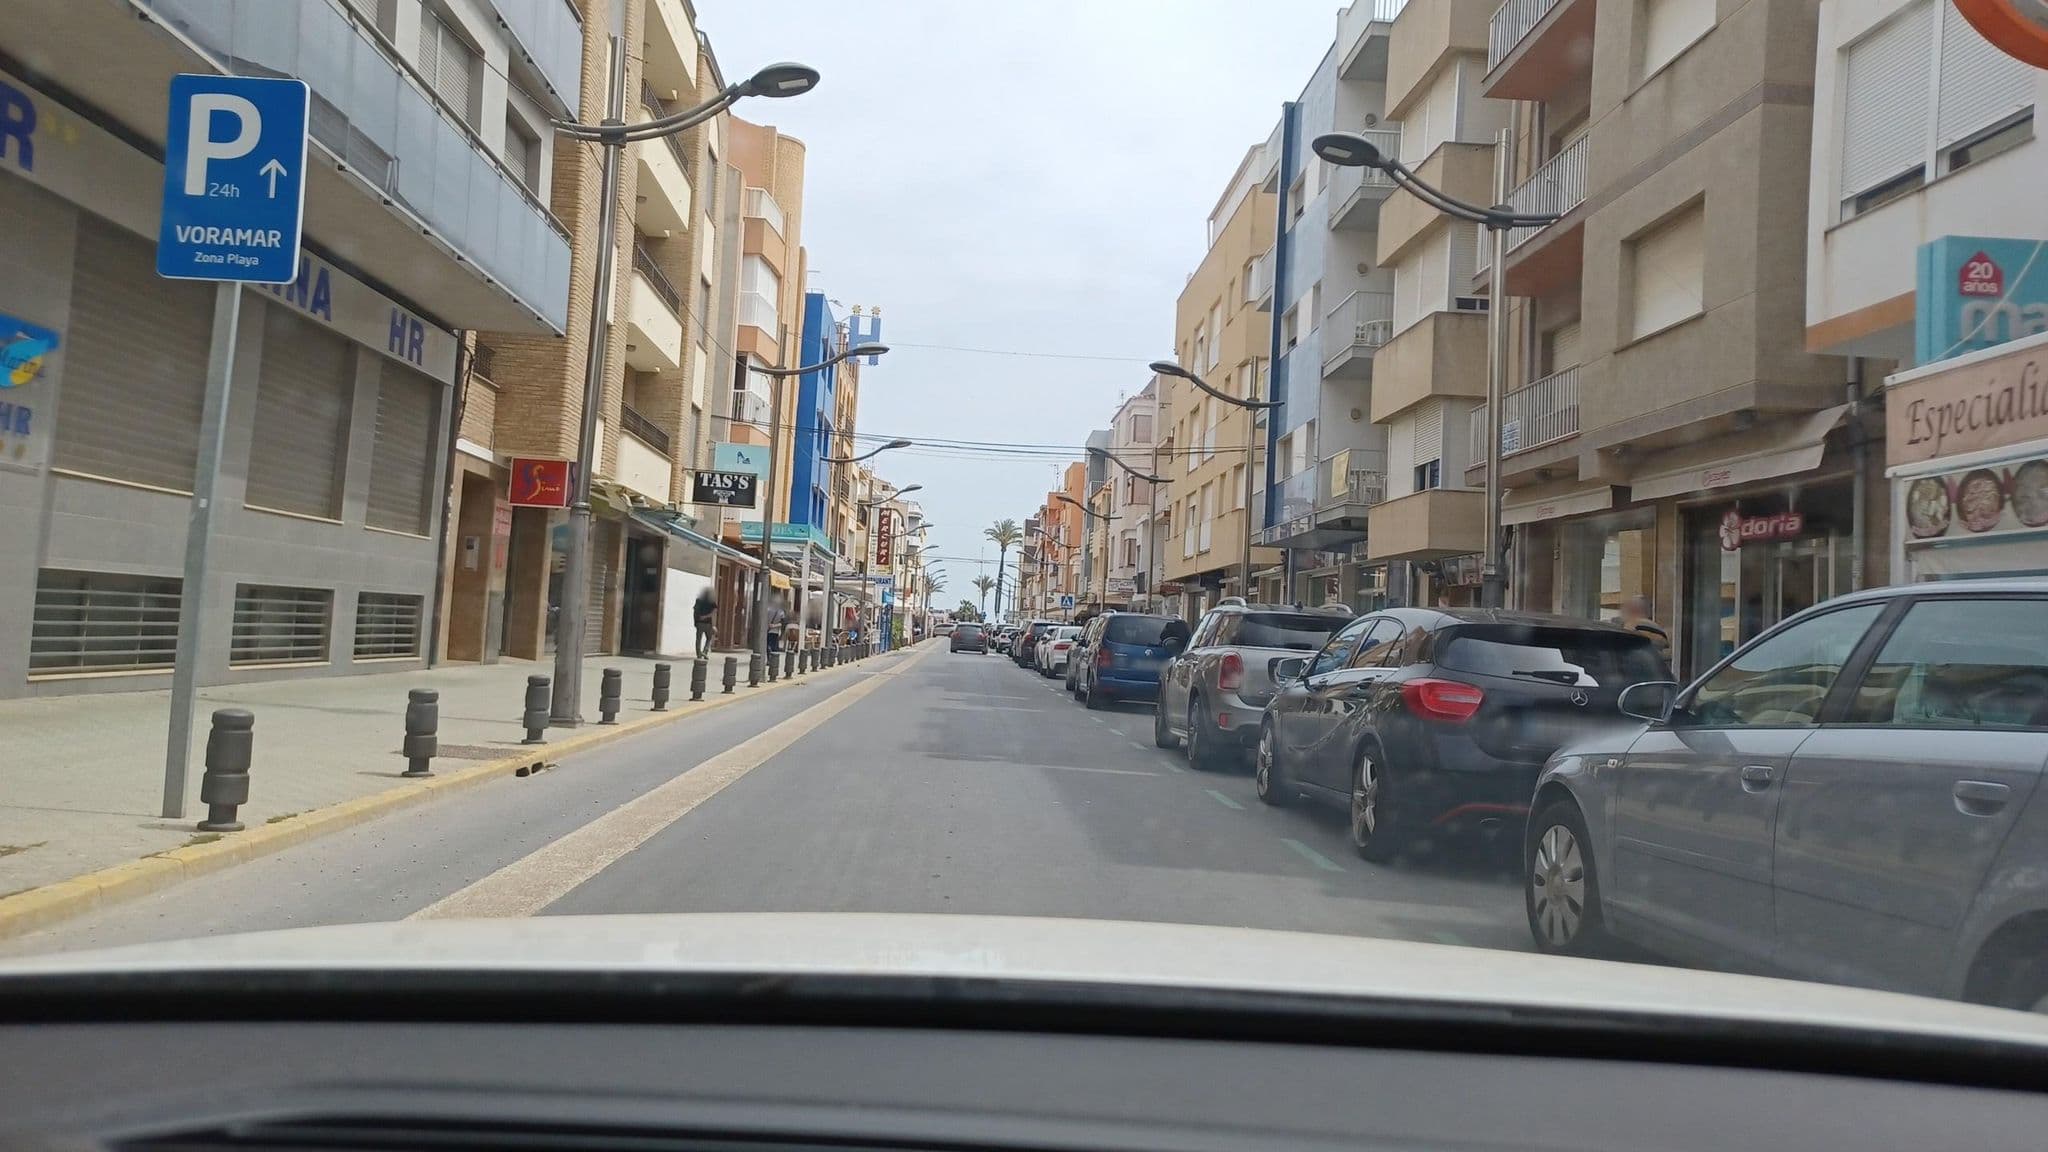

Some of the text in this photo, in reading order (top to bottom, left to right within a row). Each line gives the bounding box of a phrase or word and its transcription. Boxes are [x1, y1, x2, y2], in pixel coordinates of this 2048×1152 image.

[184, 93, 262, 196] P
[209, 182, 240, 198] 24h
[176, 224, 282, 249] VORAMAR
[194, 251, 259, 267] Zona Playa
[1968, 261, 1994, 279] 20
[1962, 279, 1999, 294] años
[389, 306, 425, 367] HR
[699, 472, 750, 490] TAS'S
[1740, 513, 1802, 537] doria
[879, 509, 891, 564] MERCURI
